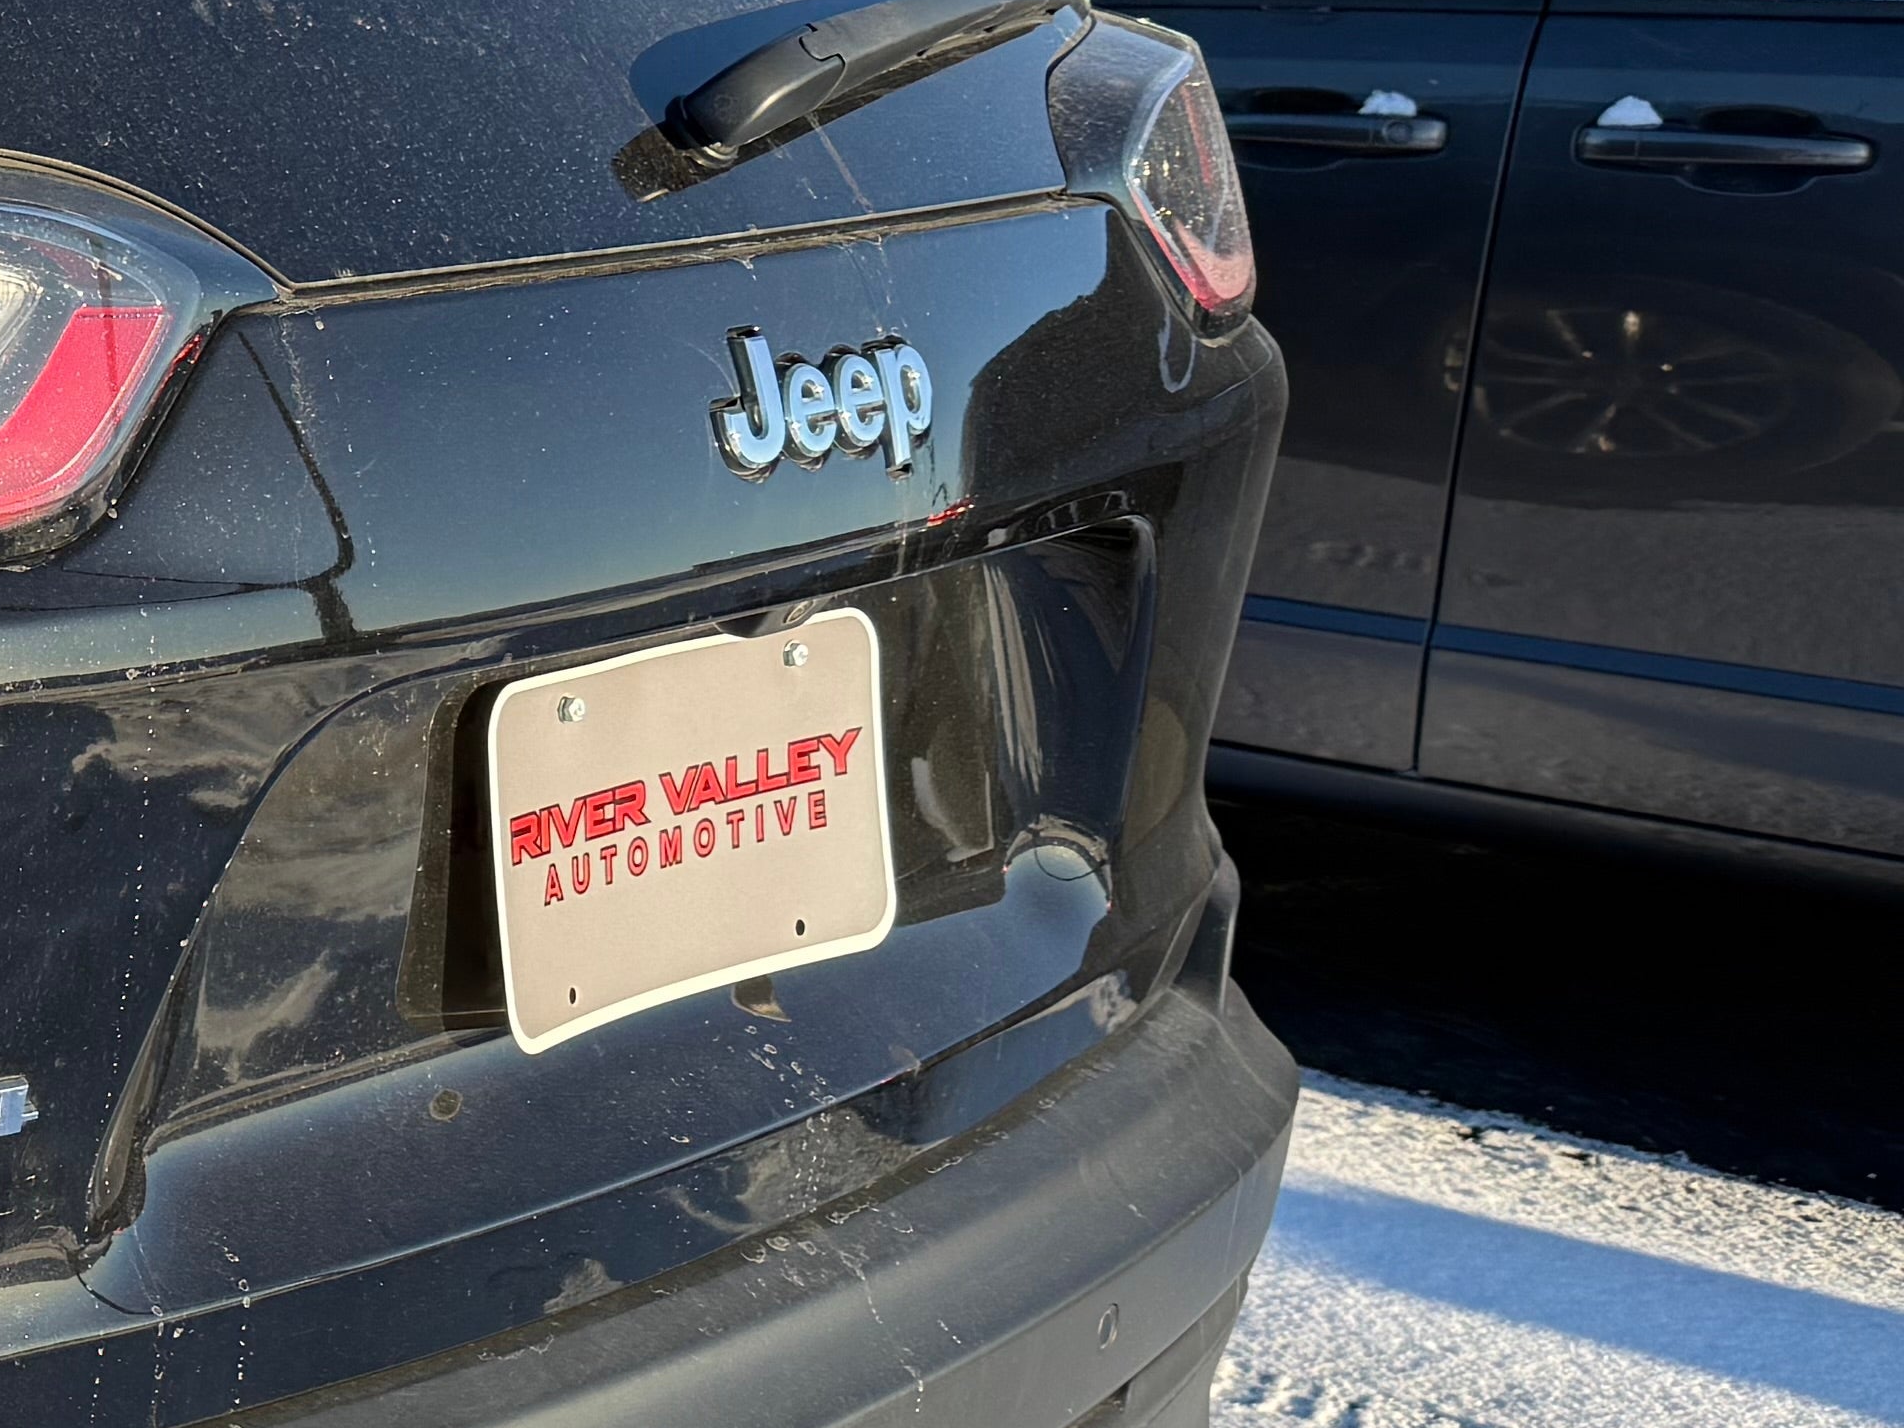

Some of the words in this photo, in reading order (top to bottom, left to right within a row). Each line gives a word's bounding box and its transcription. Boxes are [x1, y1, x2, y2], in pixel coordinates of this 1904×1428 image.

[709, 324, 933, 481] Jeep
[508, 780, 651, 867] RIVER
[658, 726, 863, 815] VALLEY
[544, 790, 828, 907] AUTOMOTIVE
